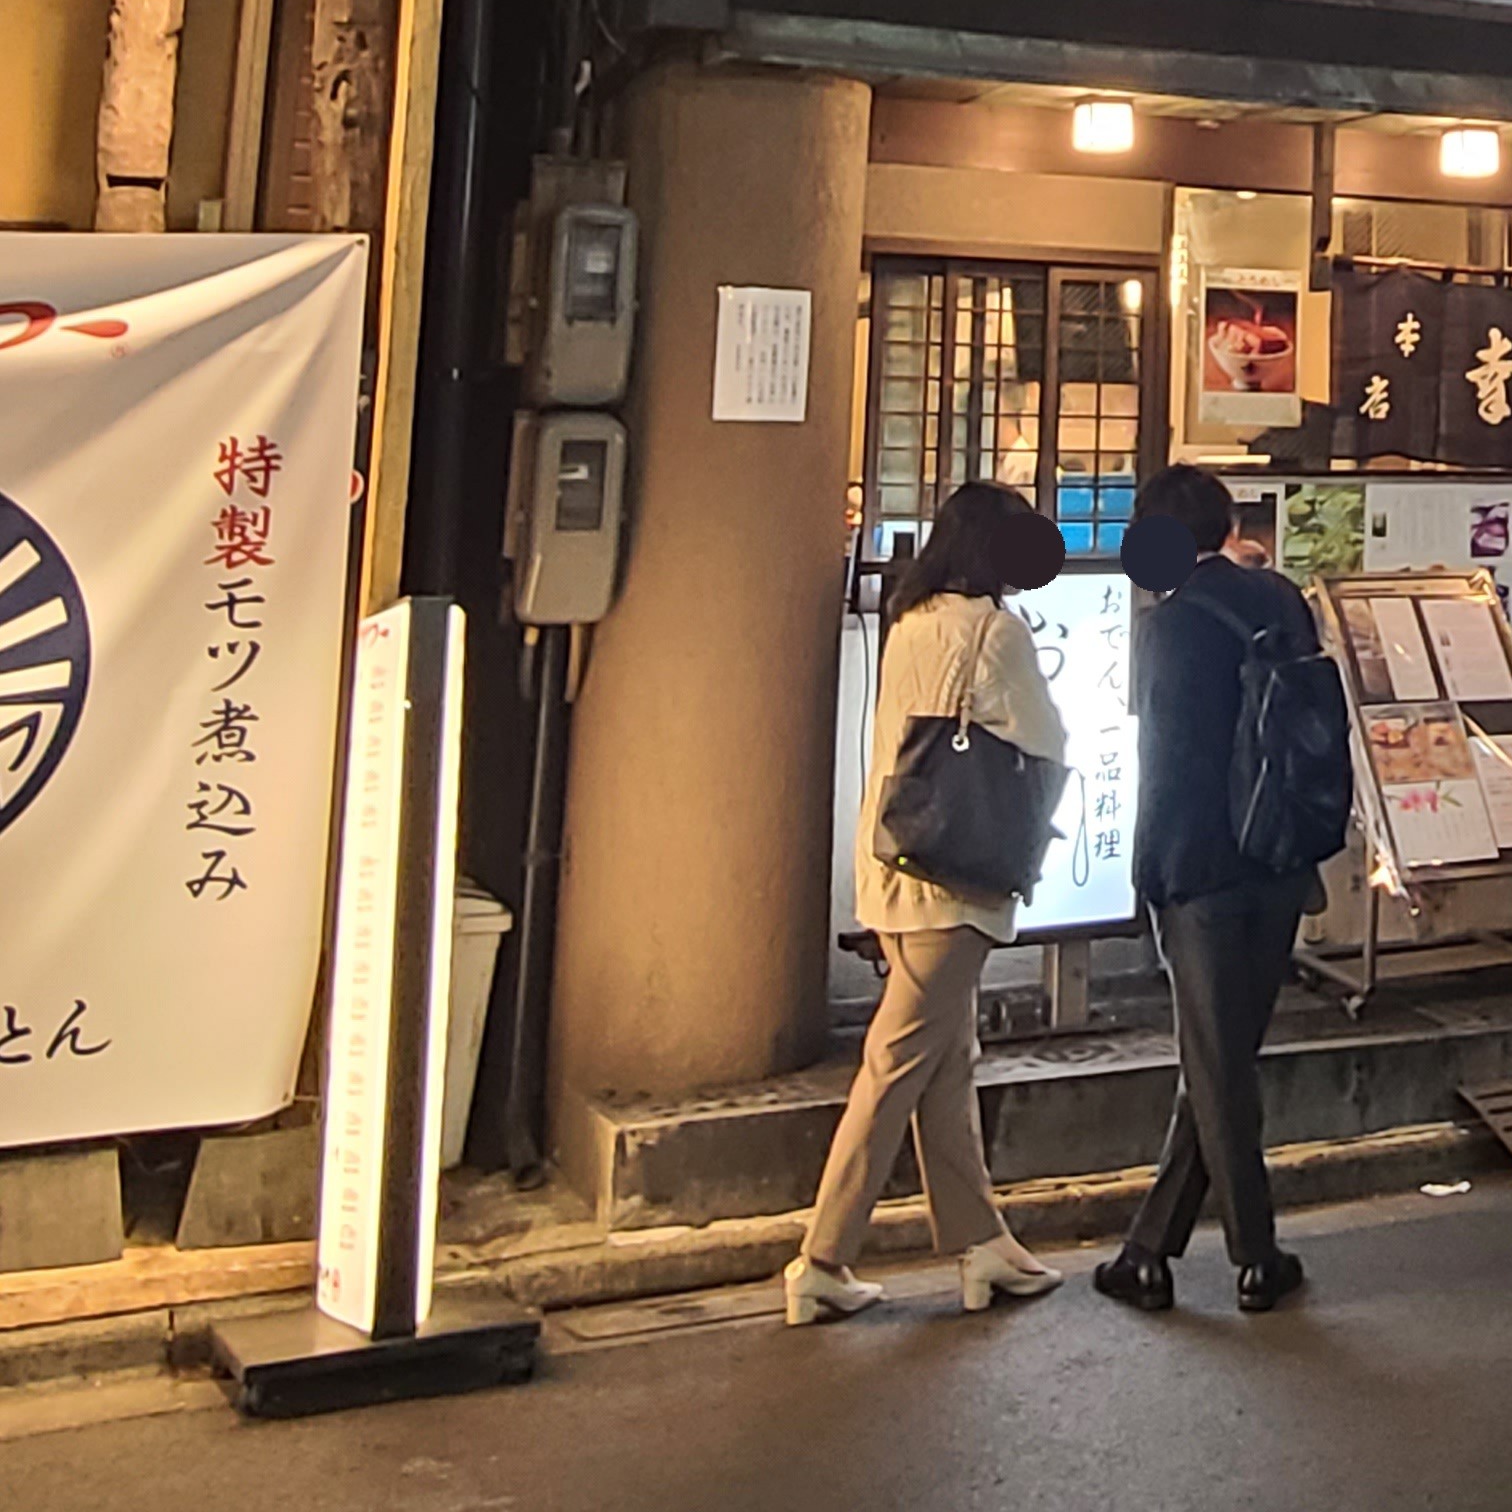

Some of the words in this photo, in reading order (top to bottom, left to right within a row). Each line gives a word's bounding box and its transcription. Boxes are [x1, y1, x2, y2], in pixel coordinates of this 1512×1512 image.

[186, 435, 283, 901] 特製モツ煮込み
